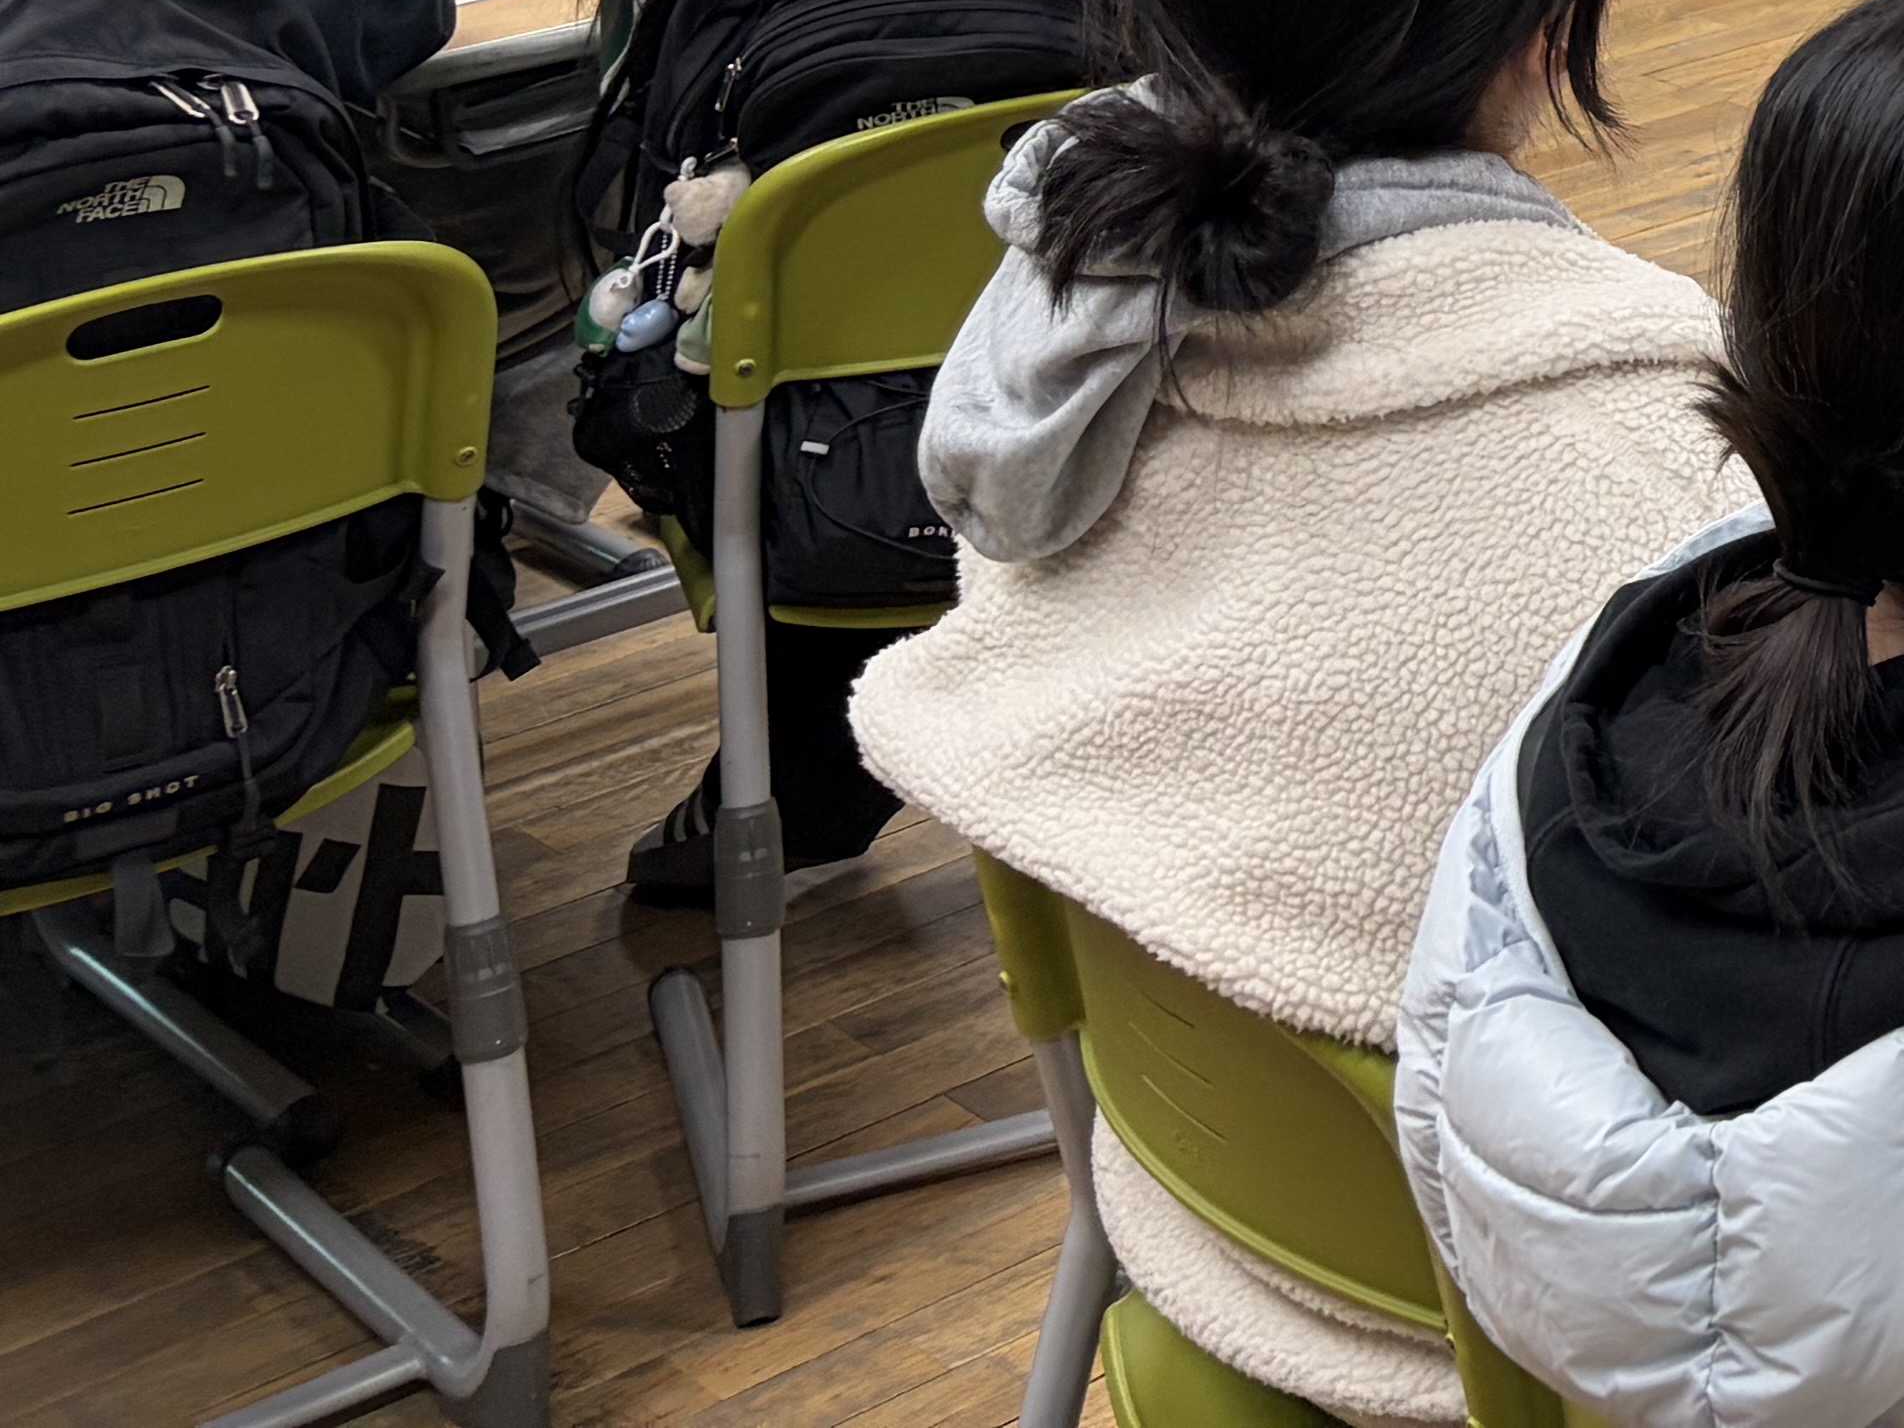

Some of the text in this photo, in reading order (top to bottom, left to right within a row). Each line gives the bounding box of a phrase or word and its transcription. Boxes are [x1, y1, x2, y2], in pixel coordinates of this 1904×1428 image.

[56, 188, 143, 215] NORTH
[76, 200, 139, 223] FACE
[127, 774, 199, 805] SHOT
